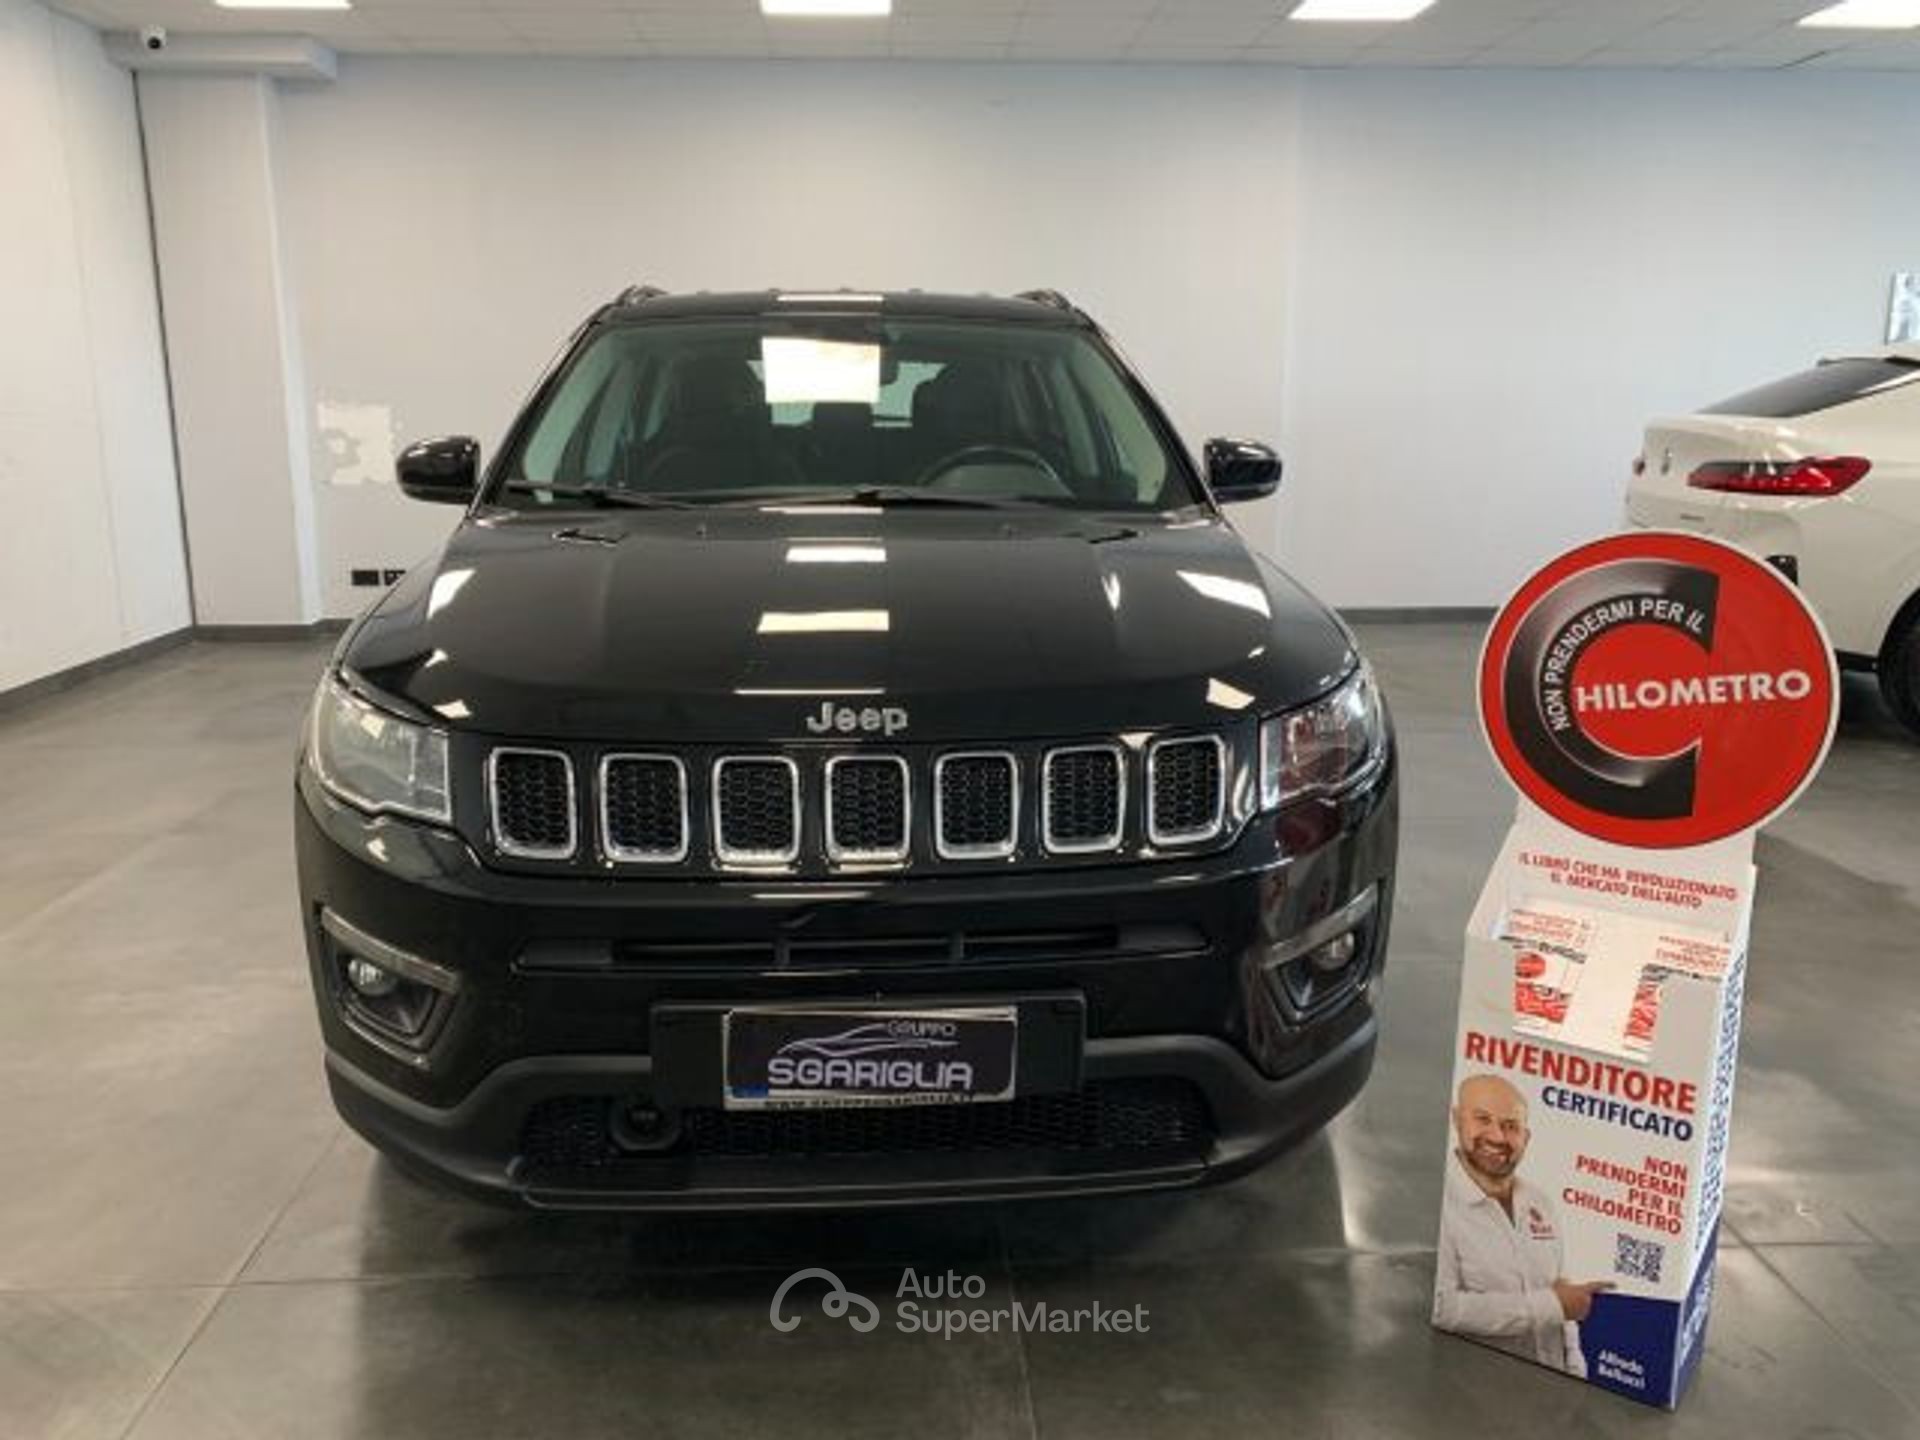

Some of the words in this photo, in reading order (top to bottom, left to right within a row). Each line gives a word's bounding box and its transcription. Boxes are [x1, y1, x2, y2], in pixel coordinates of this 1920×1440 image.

[1640, 598, 1684, 623] PER
[1686, 610, 1705, 634] IL
[1545, 600, 1634, 684] PRENDERMI
[806, 701, 908, 736] Jeep
[1544, 690, 1571, 731] NON
[1519, 852, 1529, 865] IL
[1533, 855, 1570, 871] LIBRO
[1573, 861, 1597, 877] CHE
[1626, 870, 1738, 900] RIVOLUZIONATO
[1551, 873, 1561, 884] IL
[1567, 875, 1629, 896] MERCATO
[768, 1058, 973, 1090] SGARIGLIA
[1464, 1032, 1697, 1114] RIVENDITORE
[1541, 1086, 1694, 1141] CERTIFICATO
[1575, 1155, 1686, 1199] PRENDERMI
[1644, 1156, 1688, 1180] NON
[1562, 1188, 1682, 1235] CHILOMETRO
[1628, 1188, 1665, 1211] PER
[1667, 1199, 1683, 1218] IL
